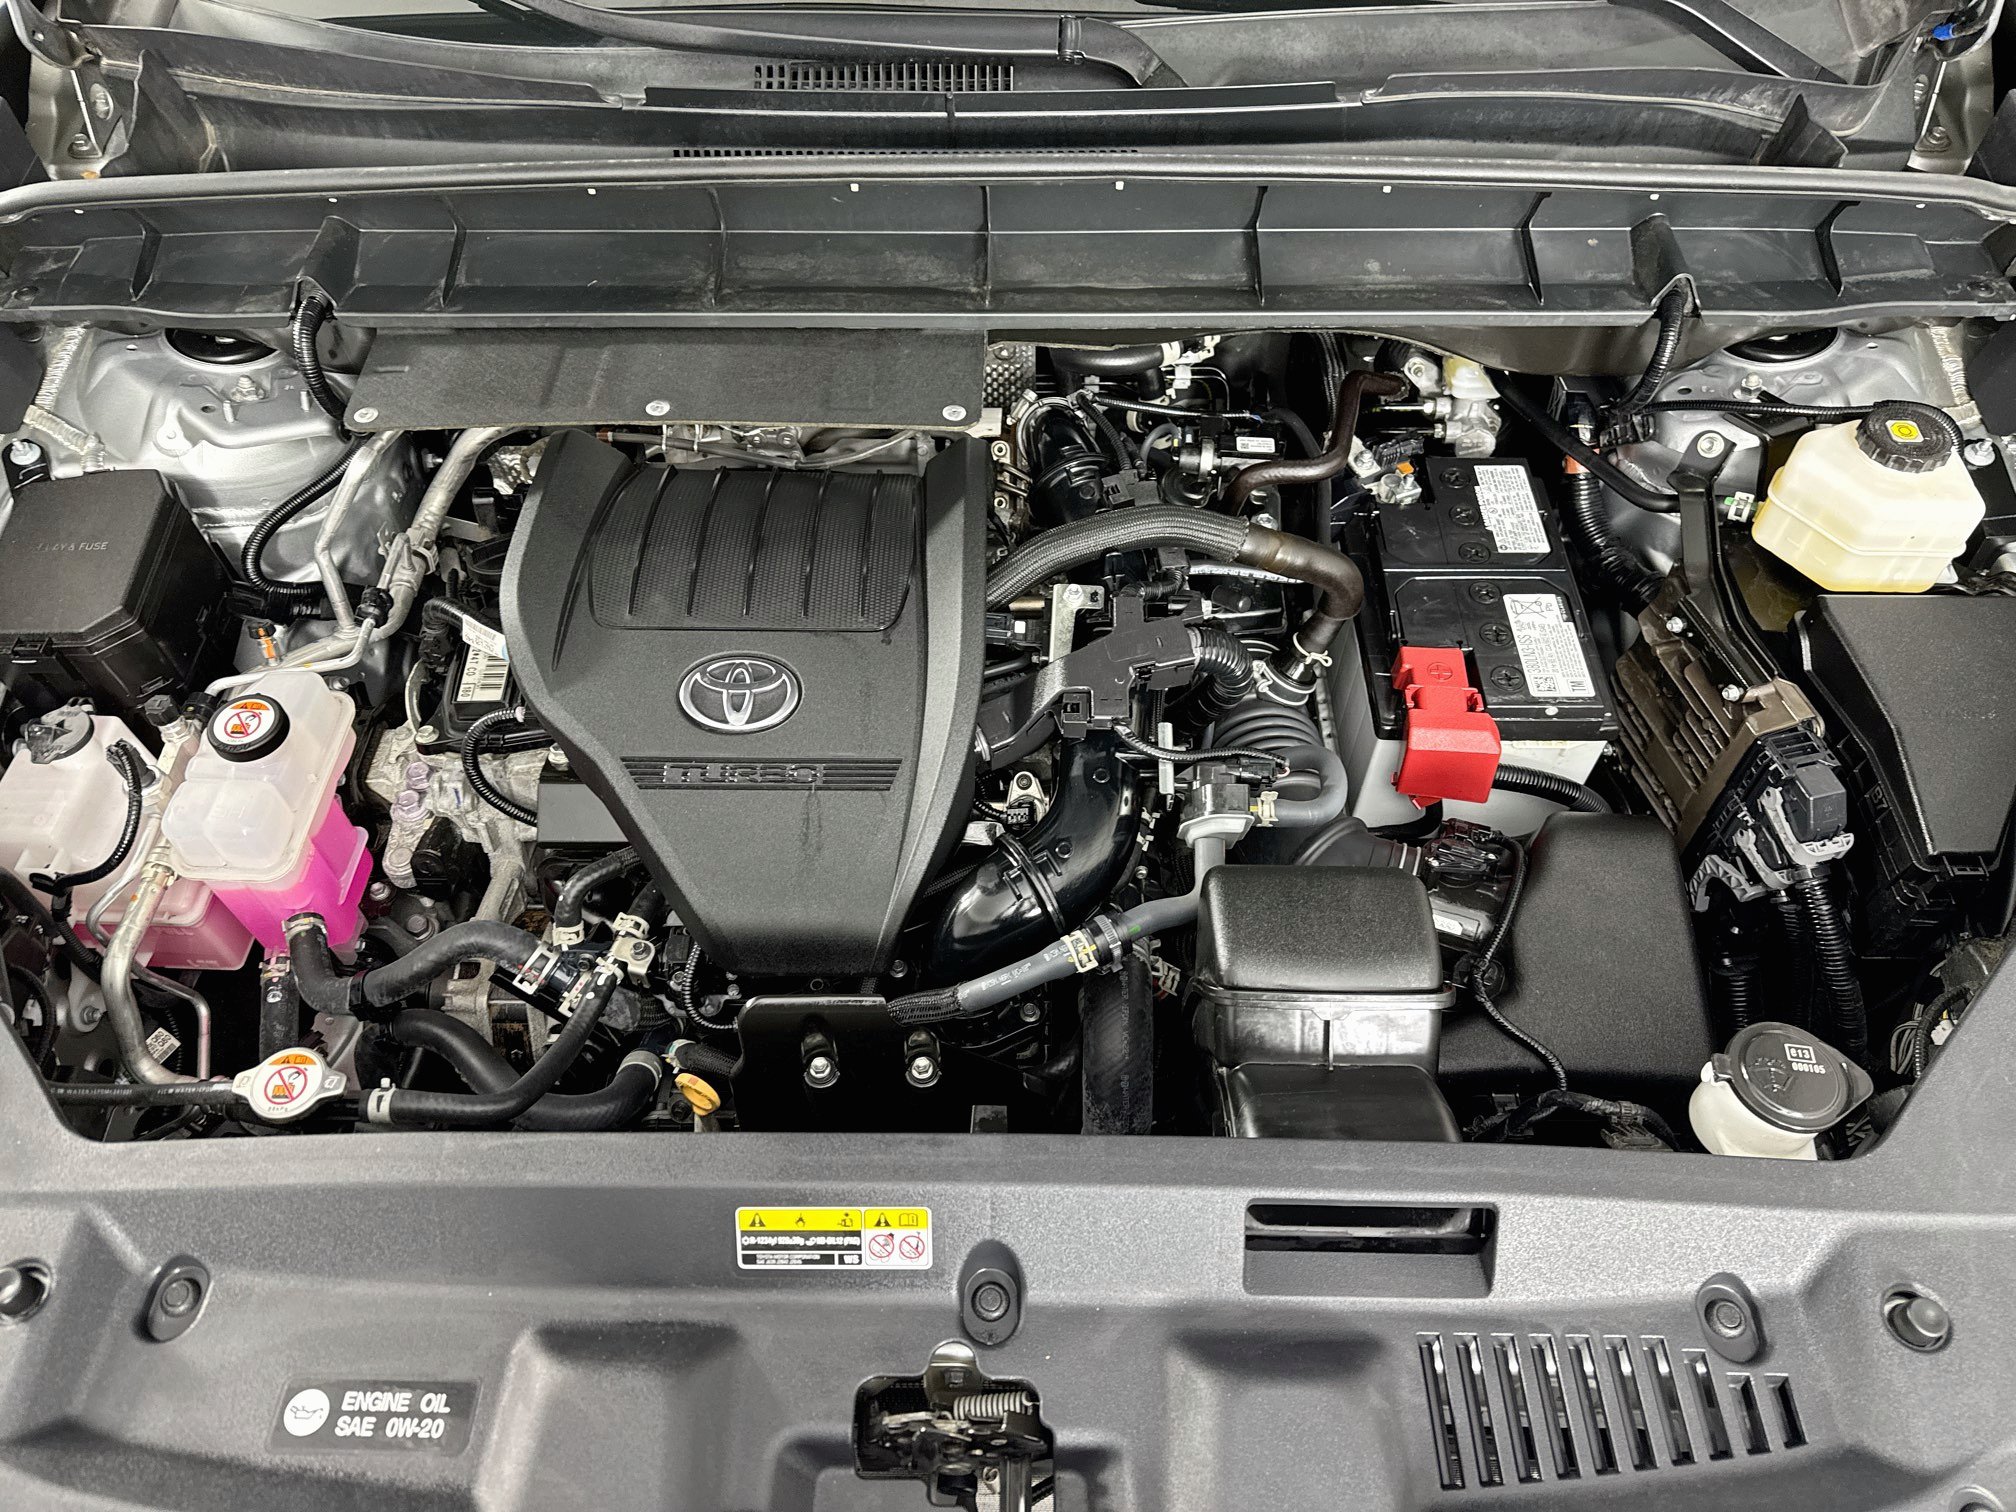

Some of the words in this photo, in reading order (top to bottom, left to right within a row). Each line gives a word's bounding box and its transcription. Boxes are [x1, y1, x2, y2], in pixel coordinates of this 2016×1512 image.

[79, 541, 109, 551] FUSE
[1545, 602, 1554, 612] Pb
[1516, 634, 1542, 674] 380LN3-ISS
[1569, 680, 1587, 692] TM
[663, 763, 824, 785] TURBO
[1870, 785, 1889, 809] B7
[1790, 1047, 1810, 1059] e13
[1791, 1061, 1826, 1075] 000105
[340, 1390, 412, 1413] ENGINE
[419, 1393, 451, 1414] OIL
[334, 1415, 377, 1438] SAE
[385, 1417, 445, 1439] 0W-20
